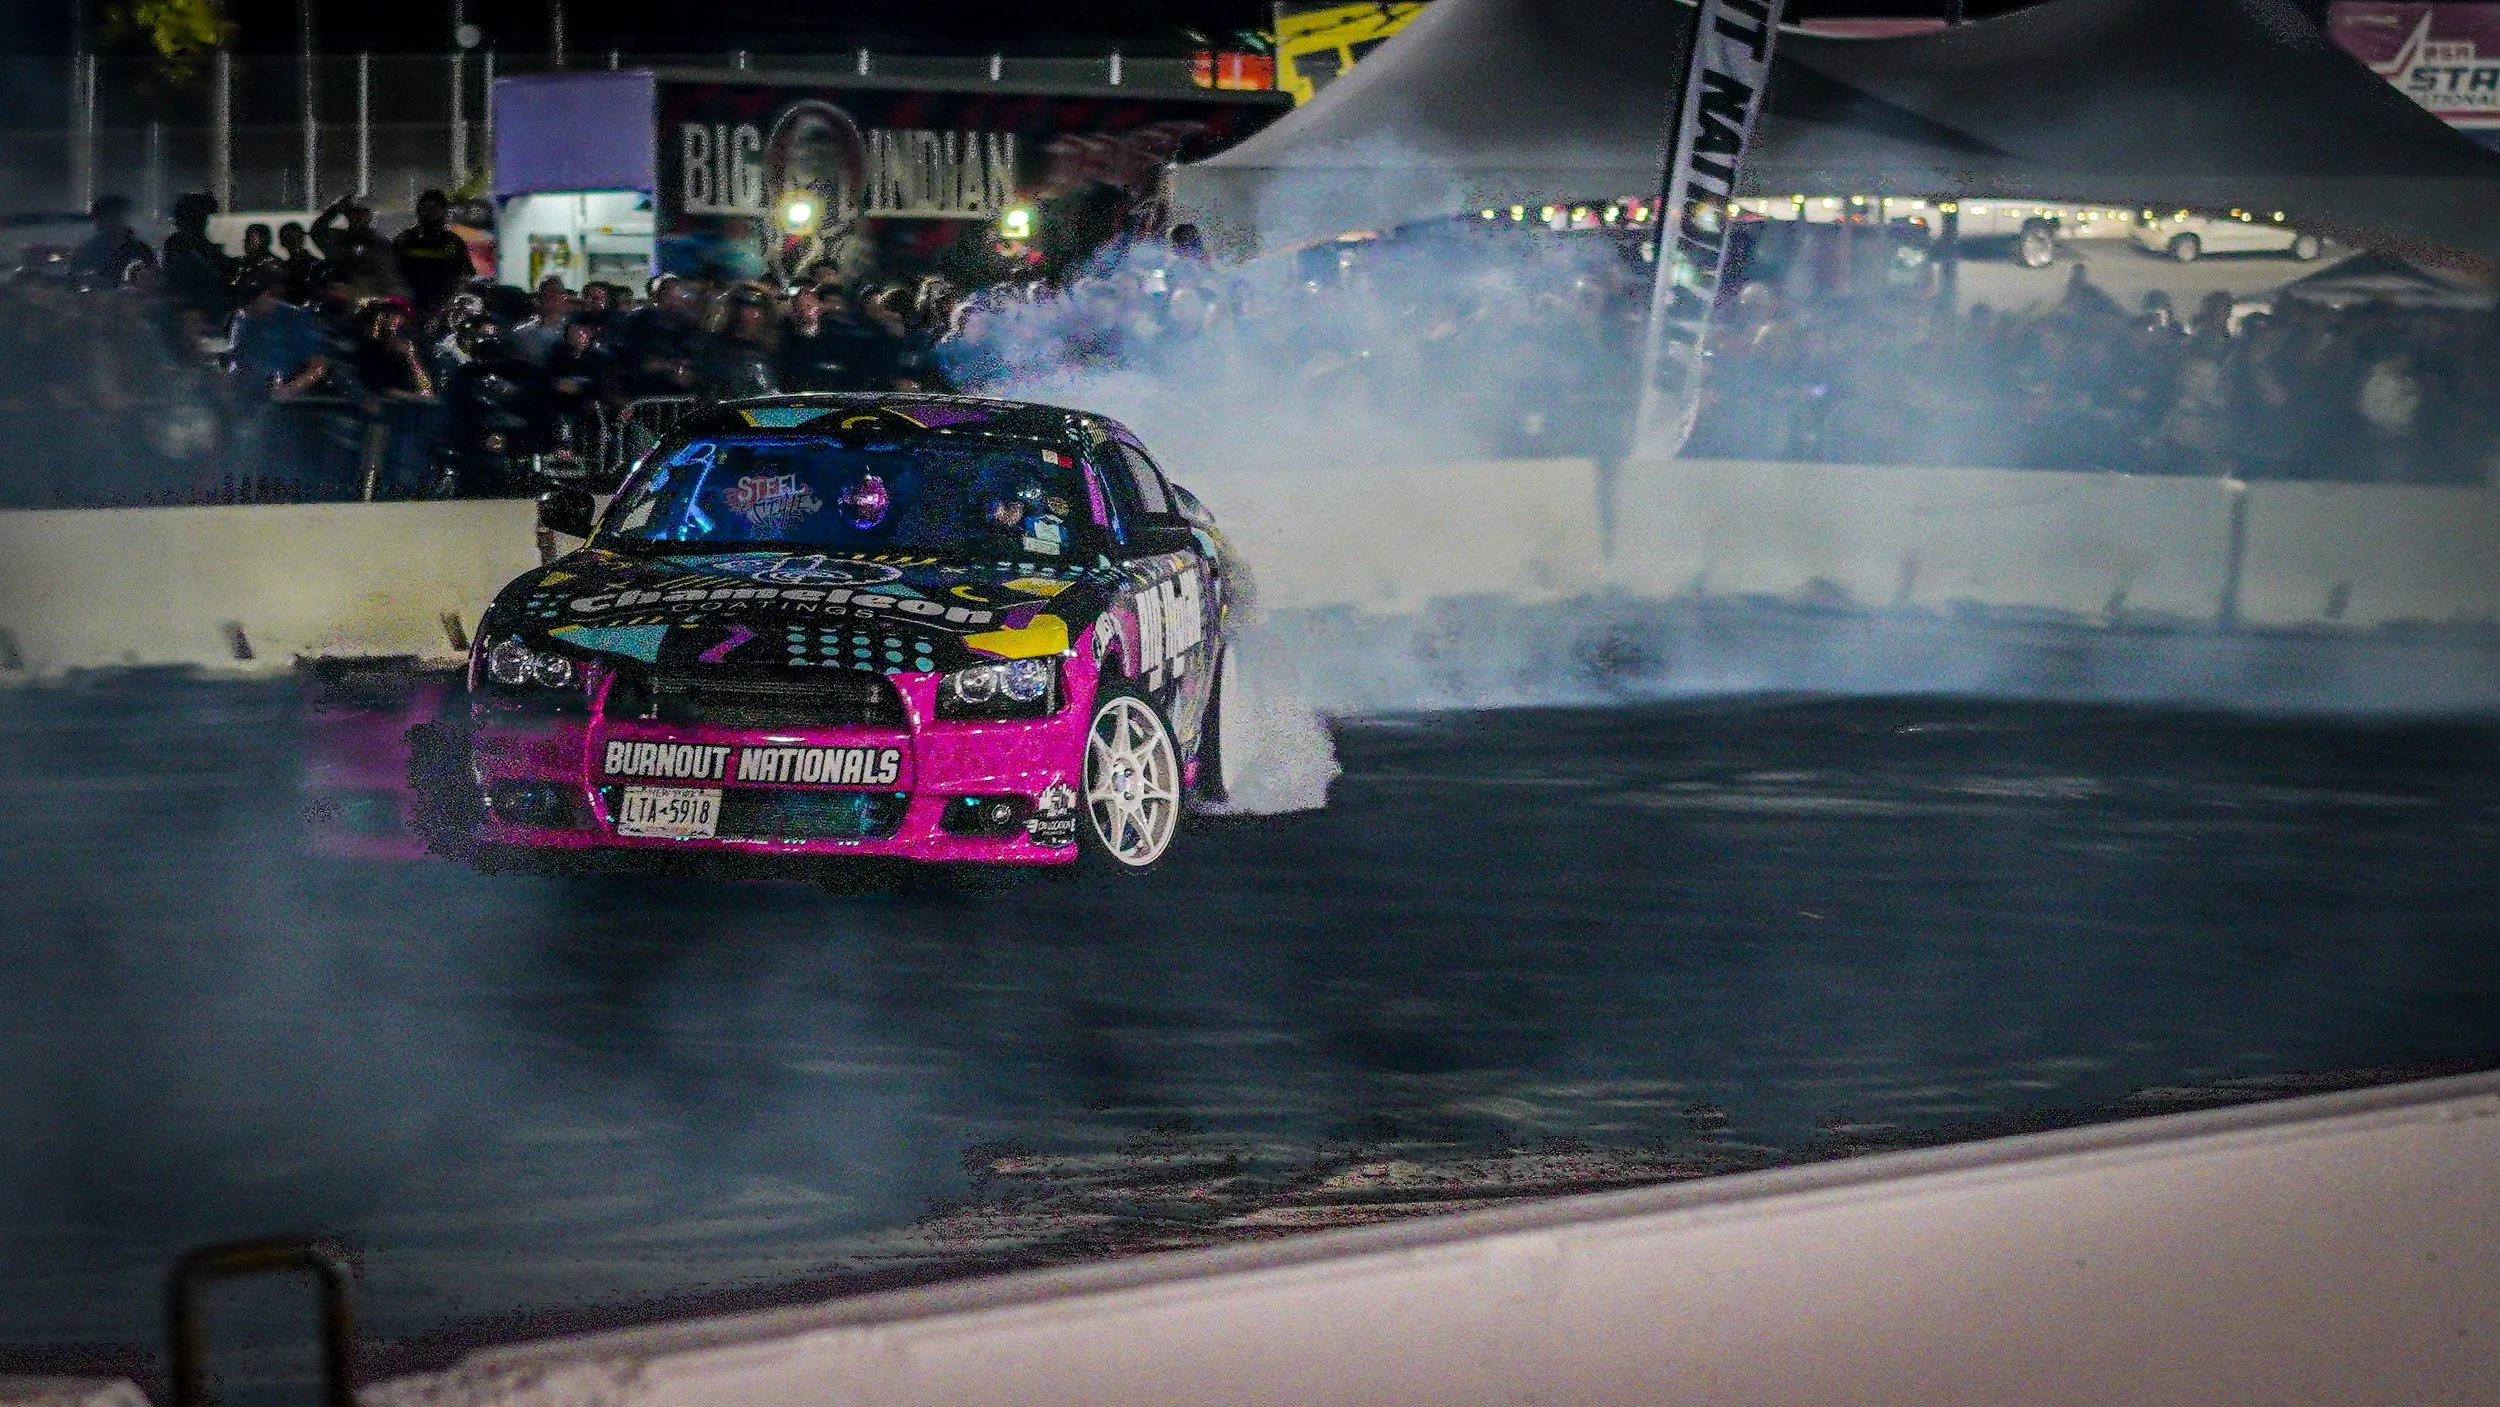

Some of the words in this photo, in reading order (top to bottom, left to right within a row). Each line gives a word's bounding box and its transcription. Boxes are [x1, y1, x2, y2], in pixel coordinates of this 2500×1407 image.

[682, 123, 764, 211] BIG
[868, 128, 1016, 211] INDIAN
[737, 473, 809, 501] STEEL
[569, 588, 993, 625] Chameleon
[671, 600, 876, 620] COATINGS
[604, 740, 733, 781] BURNOUT
[738, 746, 901, 786] NATIONALS
